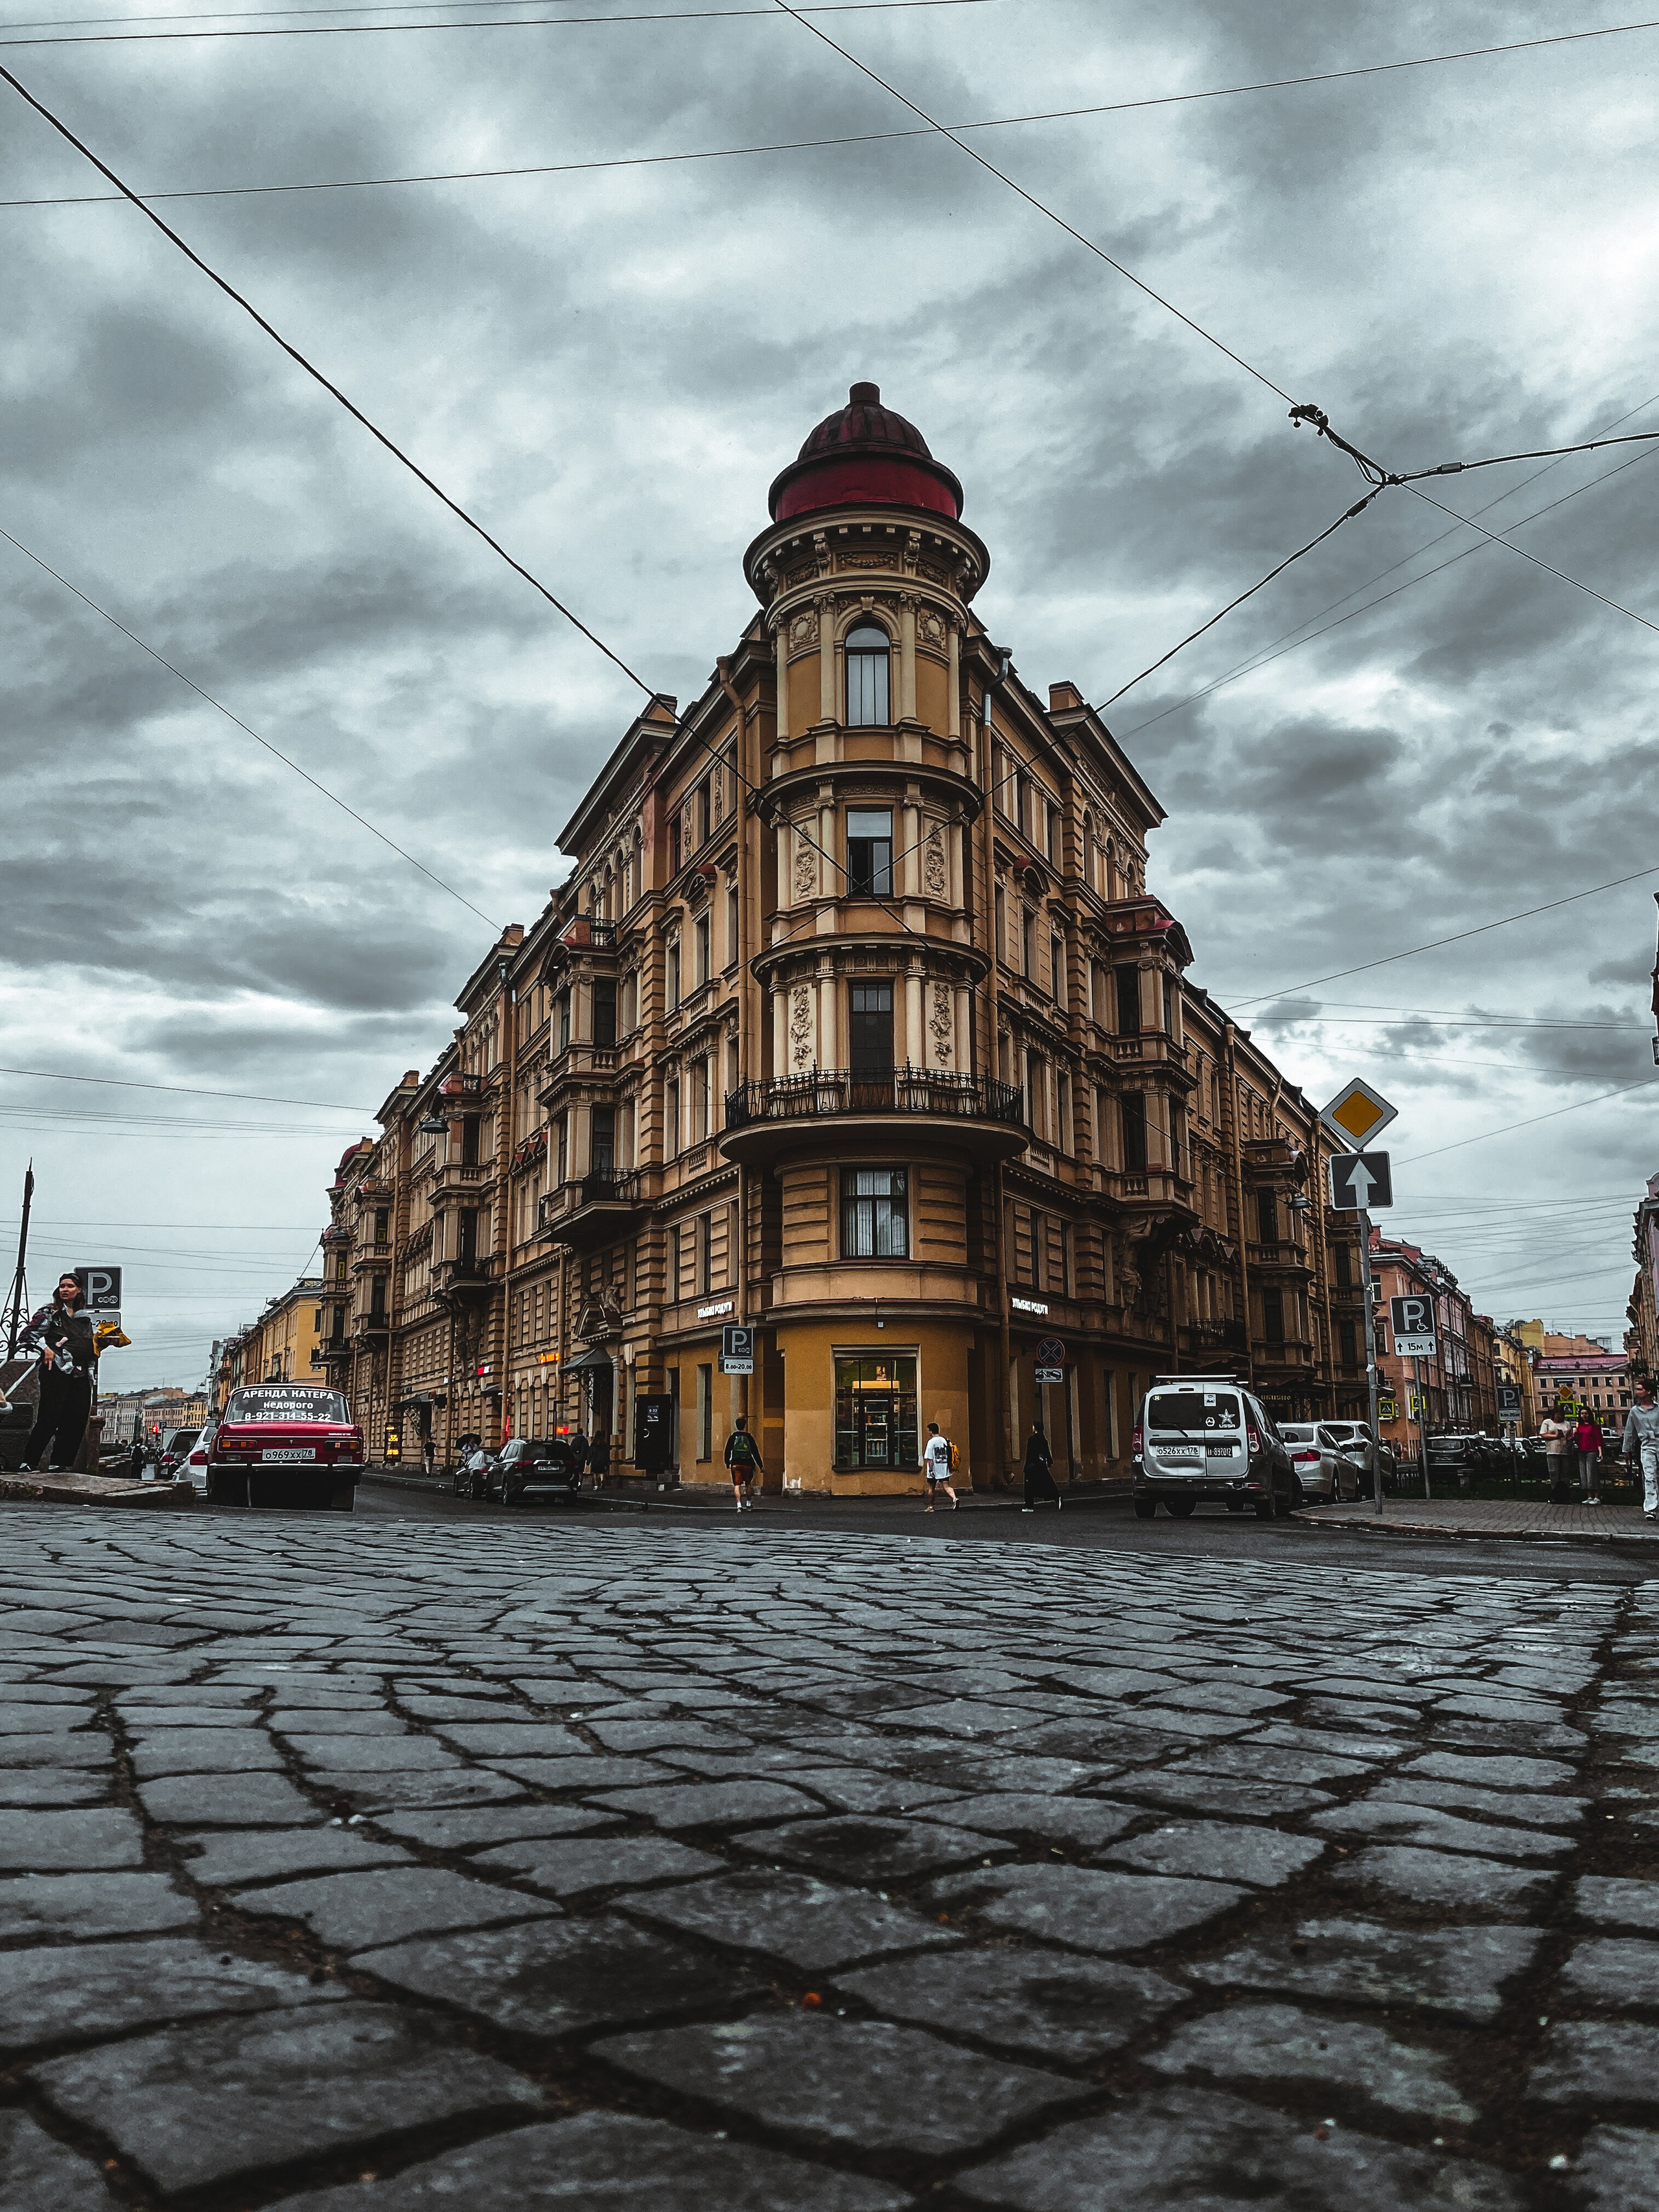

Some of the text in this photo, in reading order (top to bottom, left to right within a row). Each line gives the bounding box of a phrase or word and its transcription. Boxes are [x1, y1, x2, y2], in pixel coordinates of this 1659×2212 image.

[87, 1272, 112, 1305] P
[1402, 1300, 1424, 1331] P
[732, 1330, 747, 1353] P
[242, 1390, 334, 1400] АРЕНДА КАТЕРА
[1503, 1390, 1515, 1406] P
[263, 1401, 314, 1410] недорого
[244, 1412, 331, 1421] 8-921-314-55-22
